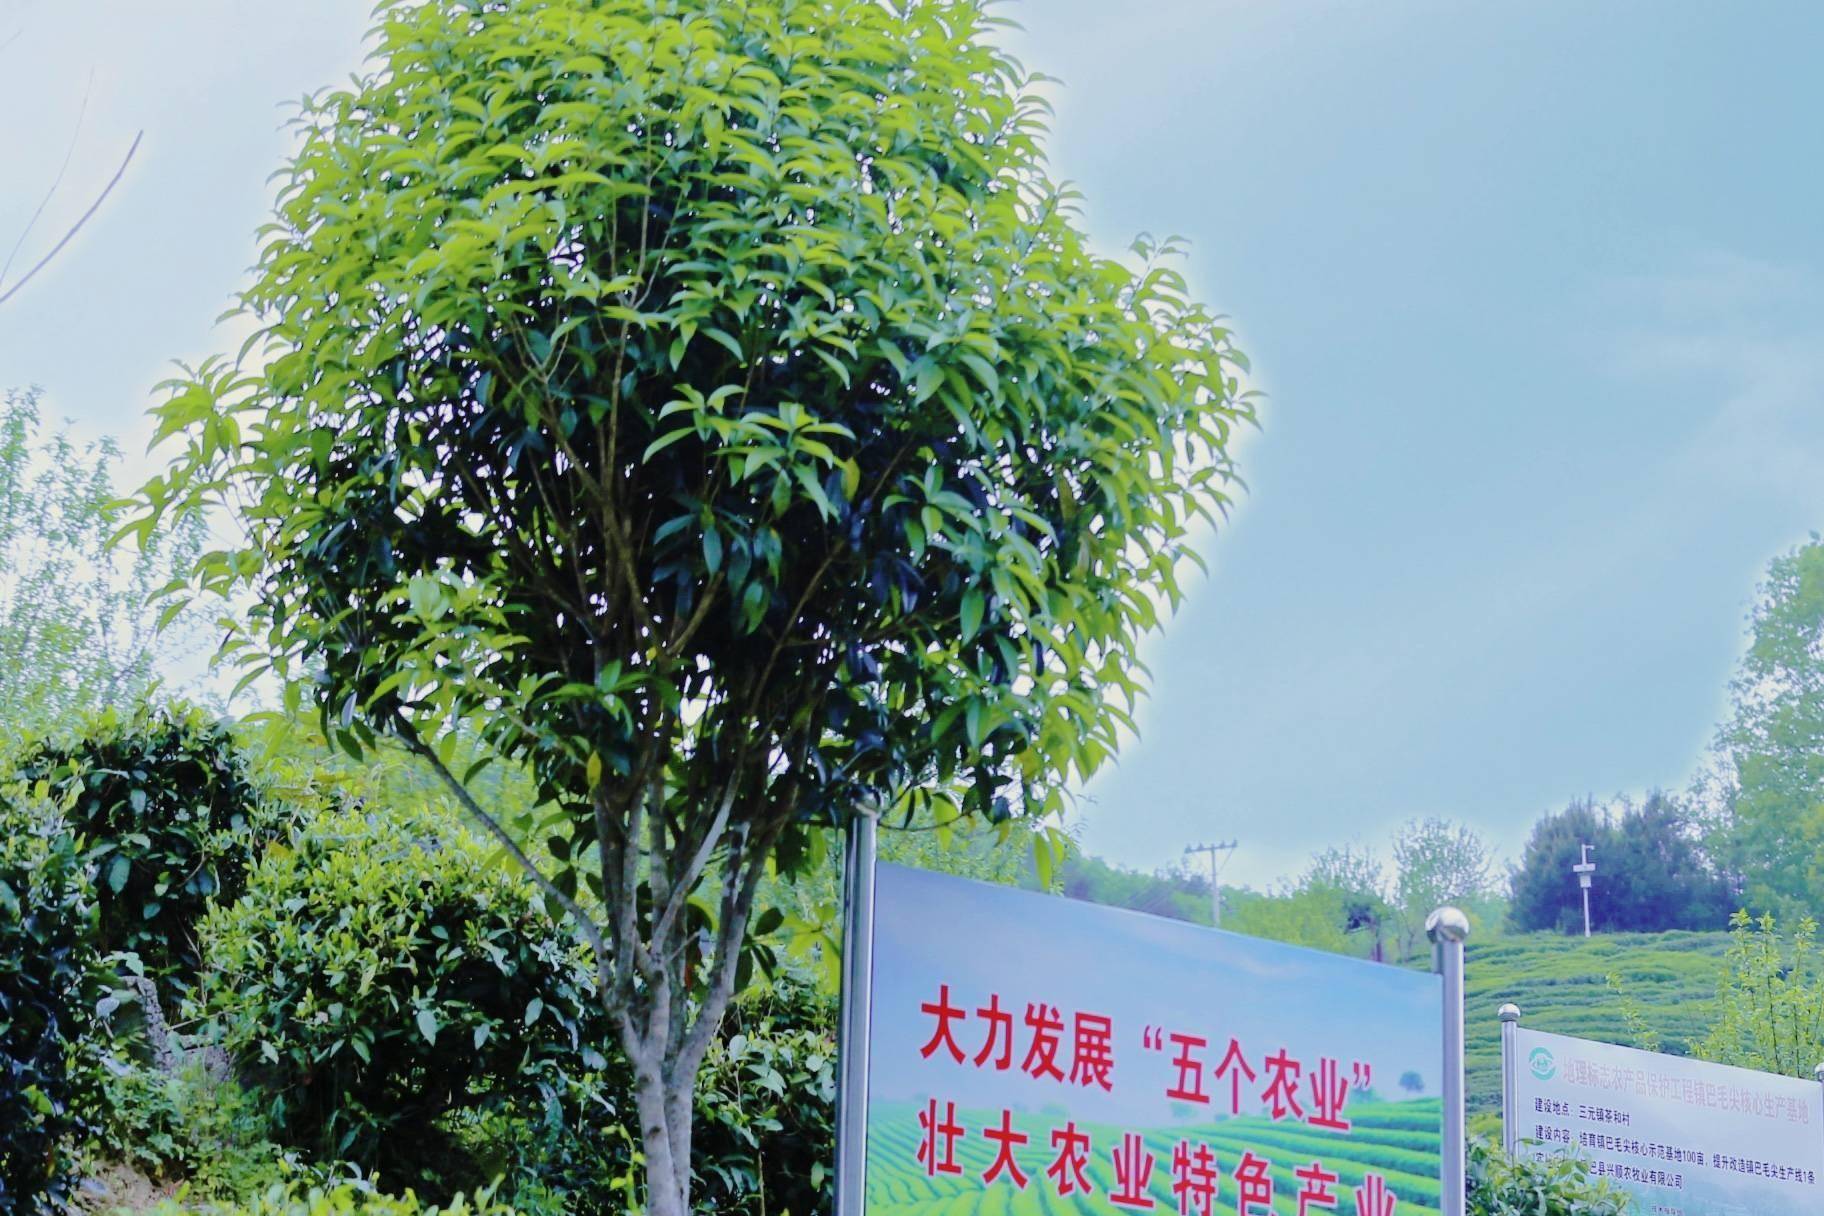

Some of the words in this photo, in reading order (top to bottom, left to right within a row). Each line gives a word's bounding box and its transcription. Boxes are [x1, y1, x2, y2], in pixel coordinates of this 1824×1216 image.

[920, 984, 1371, 1132] 大力发展“五个农业”
[1563, 1056, 1809, 1124] 地理标志农产品保护工程镇巴毛尖核心生产基地
